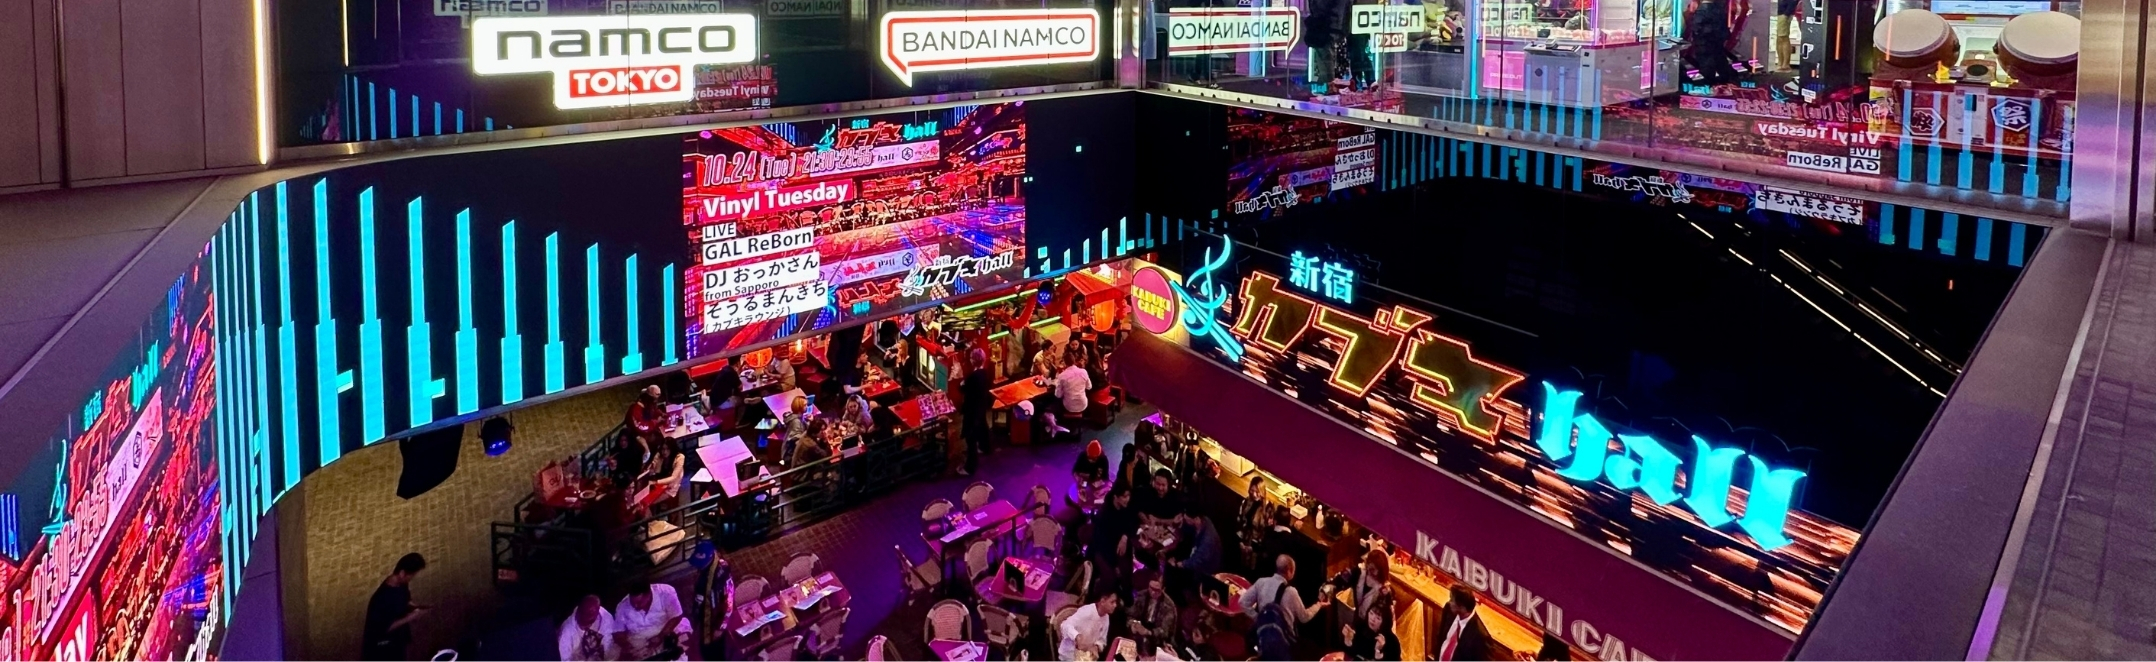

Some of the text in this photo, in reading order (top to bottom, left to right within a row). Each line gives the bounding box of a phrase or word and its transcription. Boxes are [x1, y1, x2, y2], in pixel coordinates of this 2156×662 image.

[671, 3, 717, 13] NAMCO
[497, 25, 736, 60] namco
[903, 26, 1086, 53] BANDAI NAMCO
[573, 65, 679, 95] TOKYO
[903, 121, 938, 141] hall
[703, 150, 757, 187] 10.24
[760, 152, 797, 181] (Tue)
[703, 182, 849, 218] Vinyl Tuesday
[704, 223, 735, 239] LIVE
[705, 231, 812, 260] GAL ReBorn
[706, 271, 727, 289] DJ
[733, 254, 818, 284] おっかさん
[980, 250, 1015, 276] hall
[1289, 250, 1355, 304] 新宿
[705, 280, 780, 301] from Sapporo
[1131, 285, 1171, 312] KABUKI
[1137, 299, 1165, 321] CAFE
[1535, 379, 1807, 552] hall
[1415, 529, 1564, 637] KABUKI
